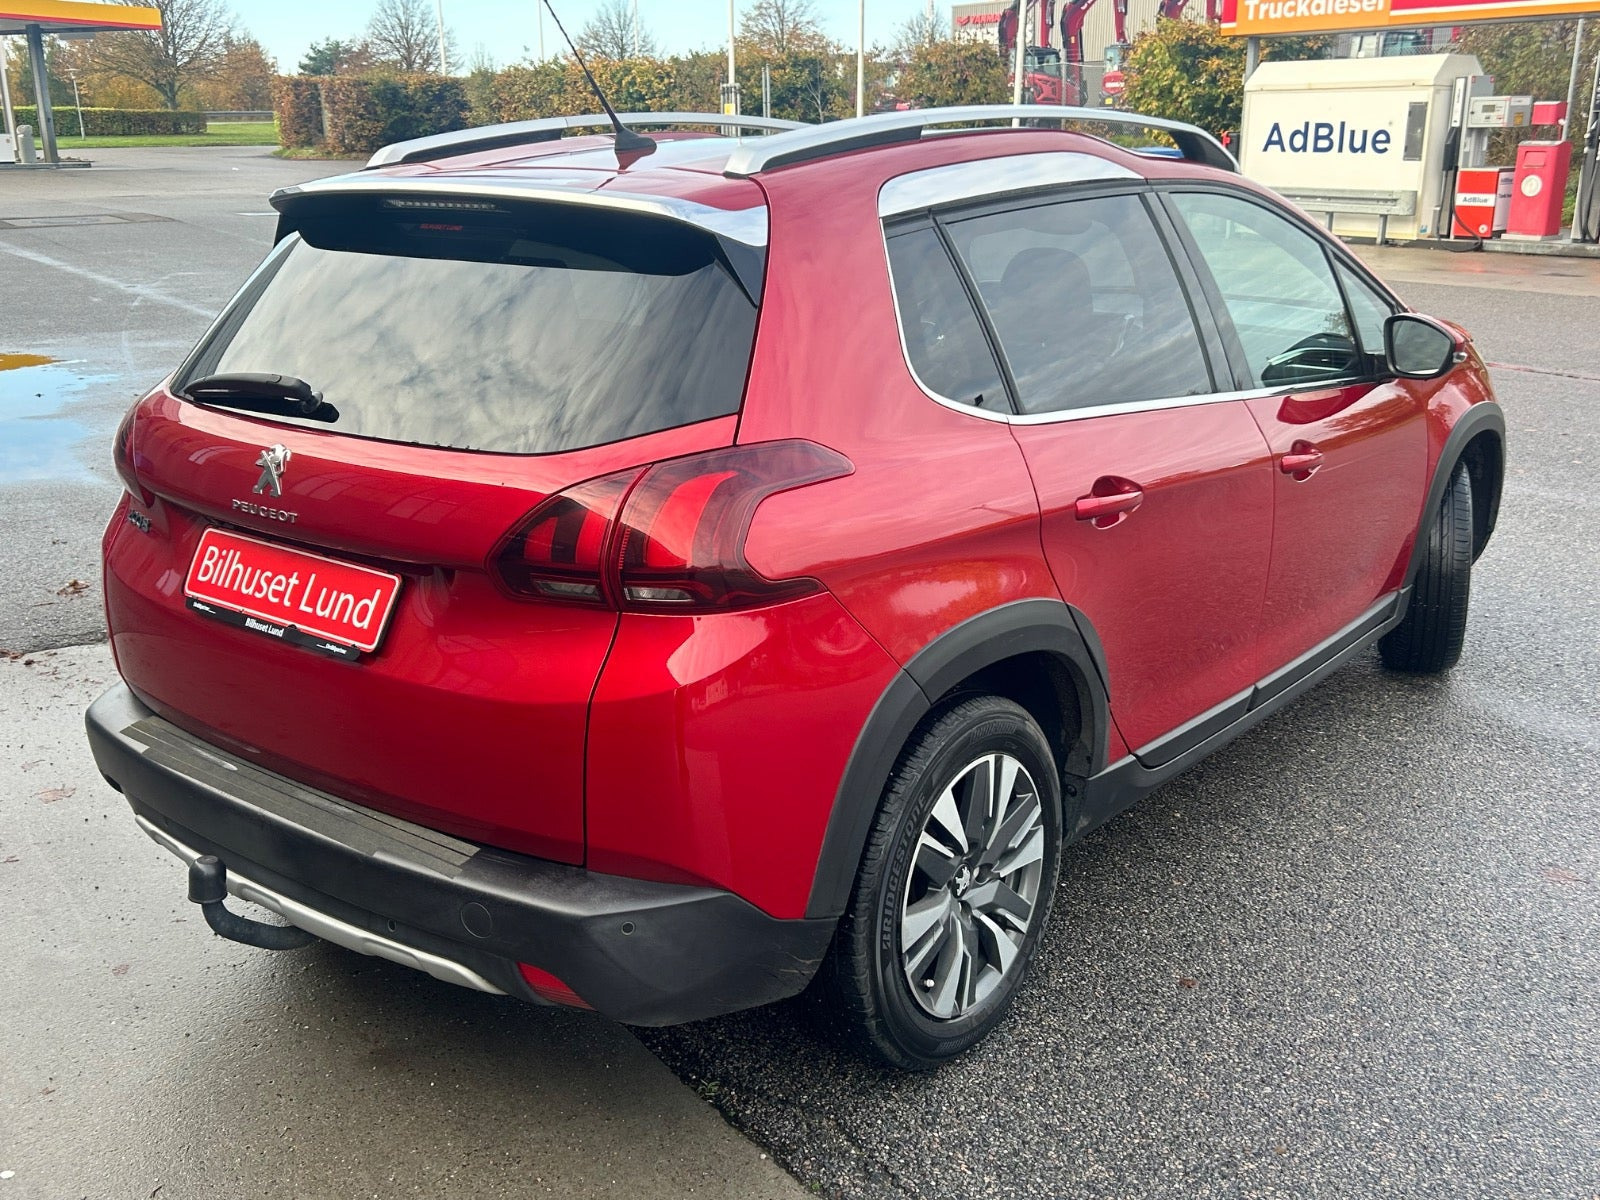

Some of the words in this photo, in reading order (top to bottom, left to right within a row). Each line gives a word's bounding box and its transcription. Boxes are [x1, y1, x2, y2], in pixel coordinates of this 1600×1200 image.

[970, 13, 1001, 24] YANMA
[1244, 0, 1385, 20] Truckdiesel
[1262, 121, 1391, 154] AdBlue
[231, 498, 298, 524] PEUGEOT
[197, 545, 300, 607] Bilhuset
[299, 573, 381, 630] Lund
[244, 617, 269, 633] Bilhuset
[267, 624, 285, 638] Lund
[882, 792, 926, 950] BRIDGESTONE
